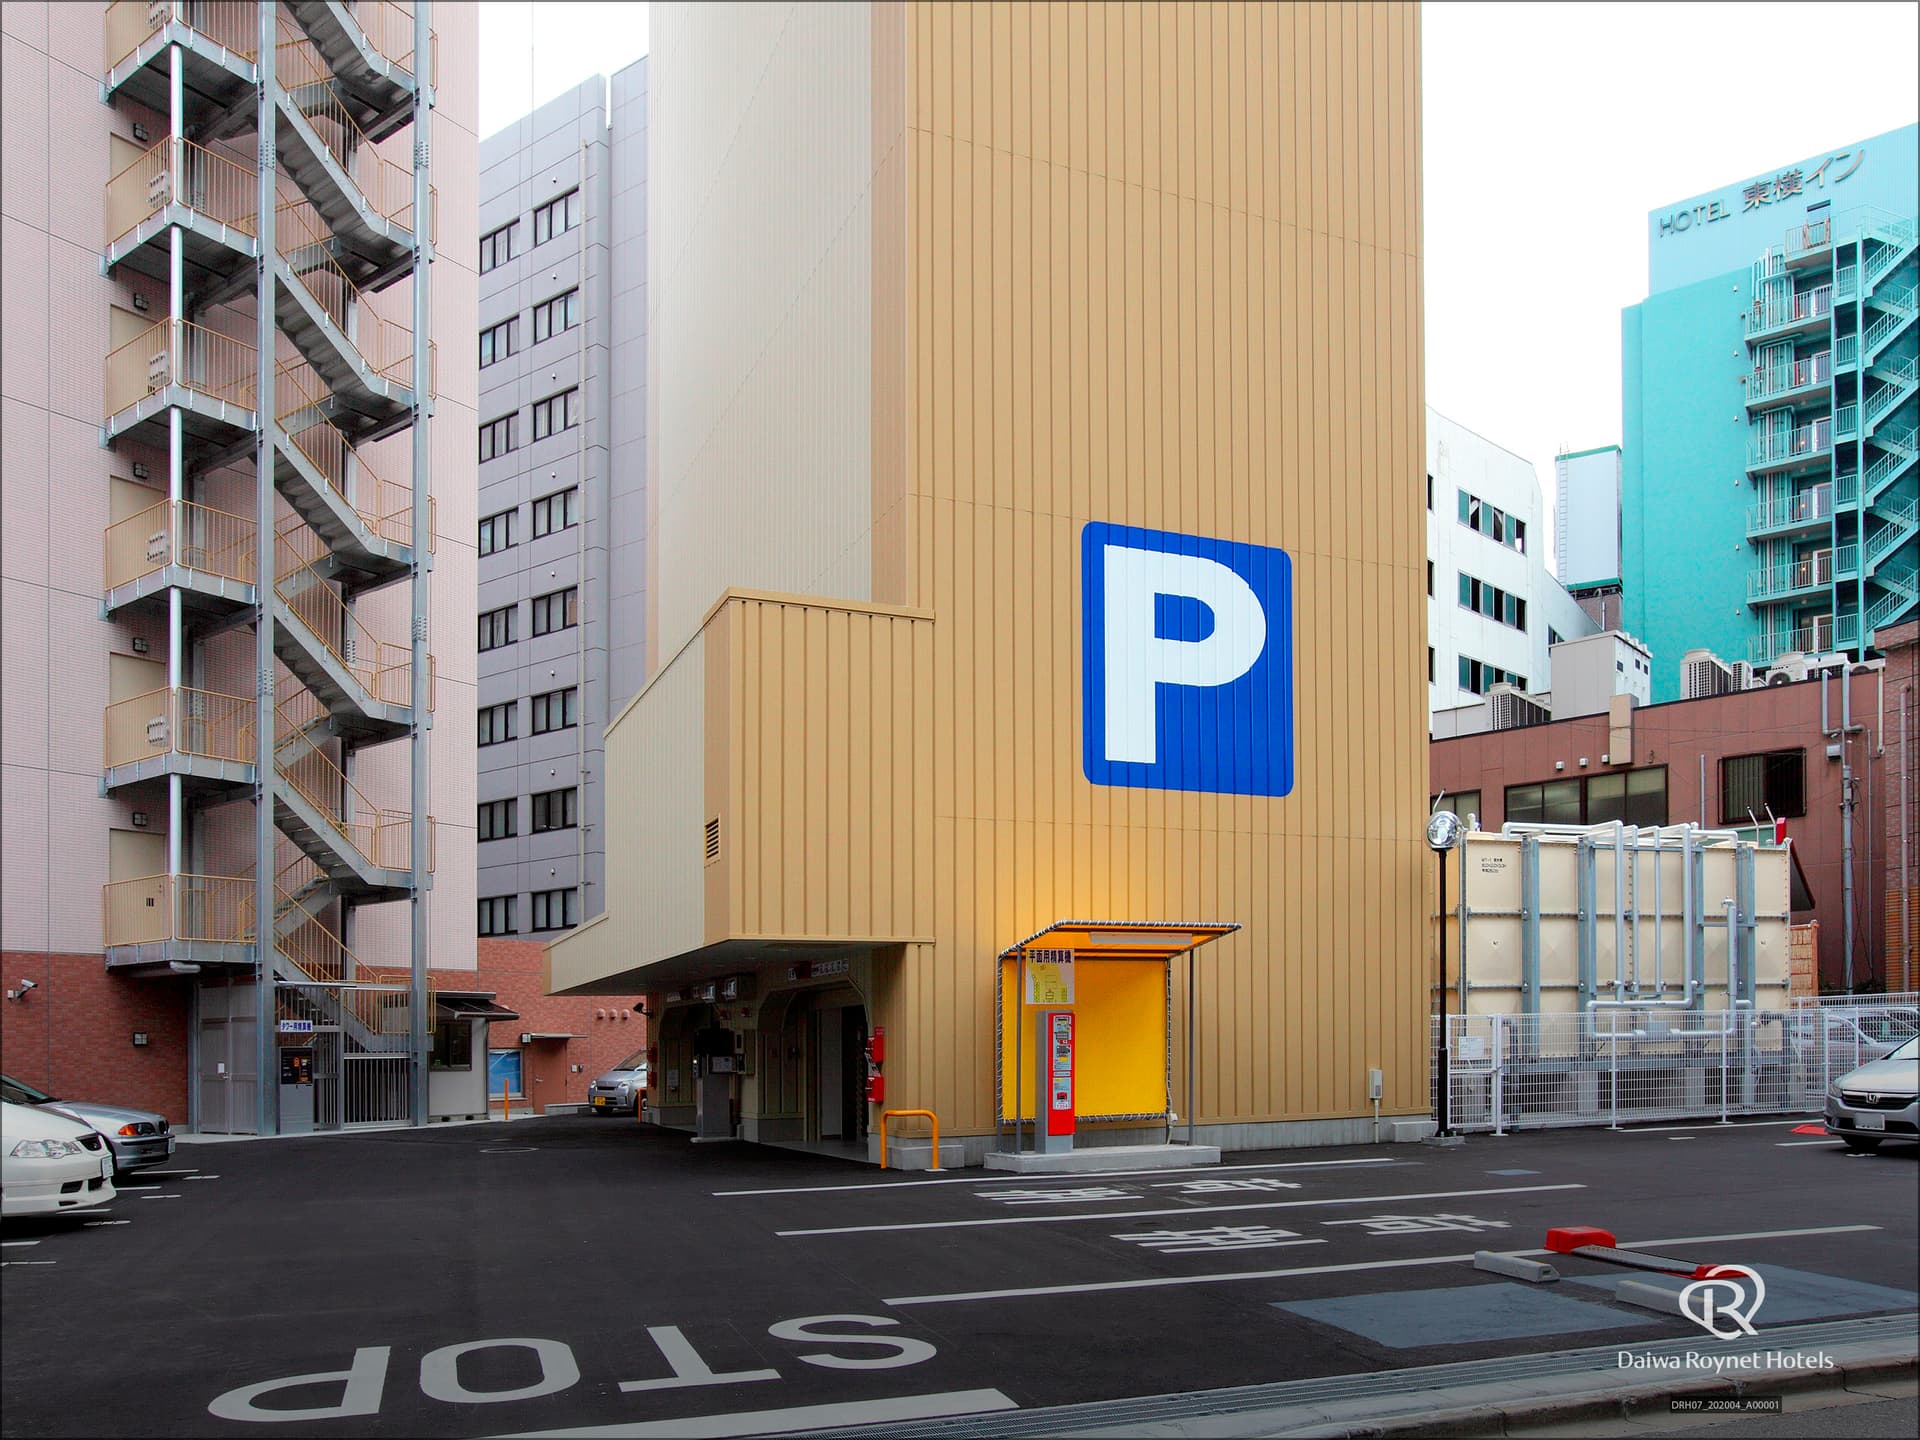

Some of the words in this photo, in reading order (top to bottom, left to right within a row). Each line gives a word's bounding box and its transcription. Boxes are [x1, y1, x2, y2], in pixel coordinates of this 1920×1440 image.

[1659, 199, 1731, 238] HOTEL
[1742, 149, 1865, 214] 東横イン
[1104, 543, 1266, 764] P
[1029, 949, 1072, 964] 平面用精算機
[207, 1313, 938, 1423] STOP
